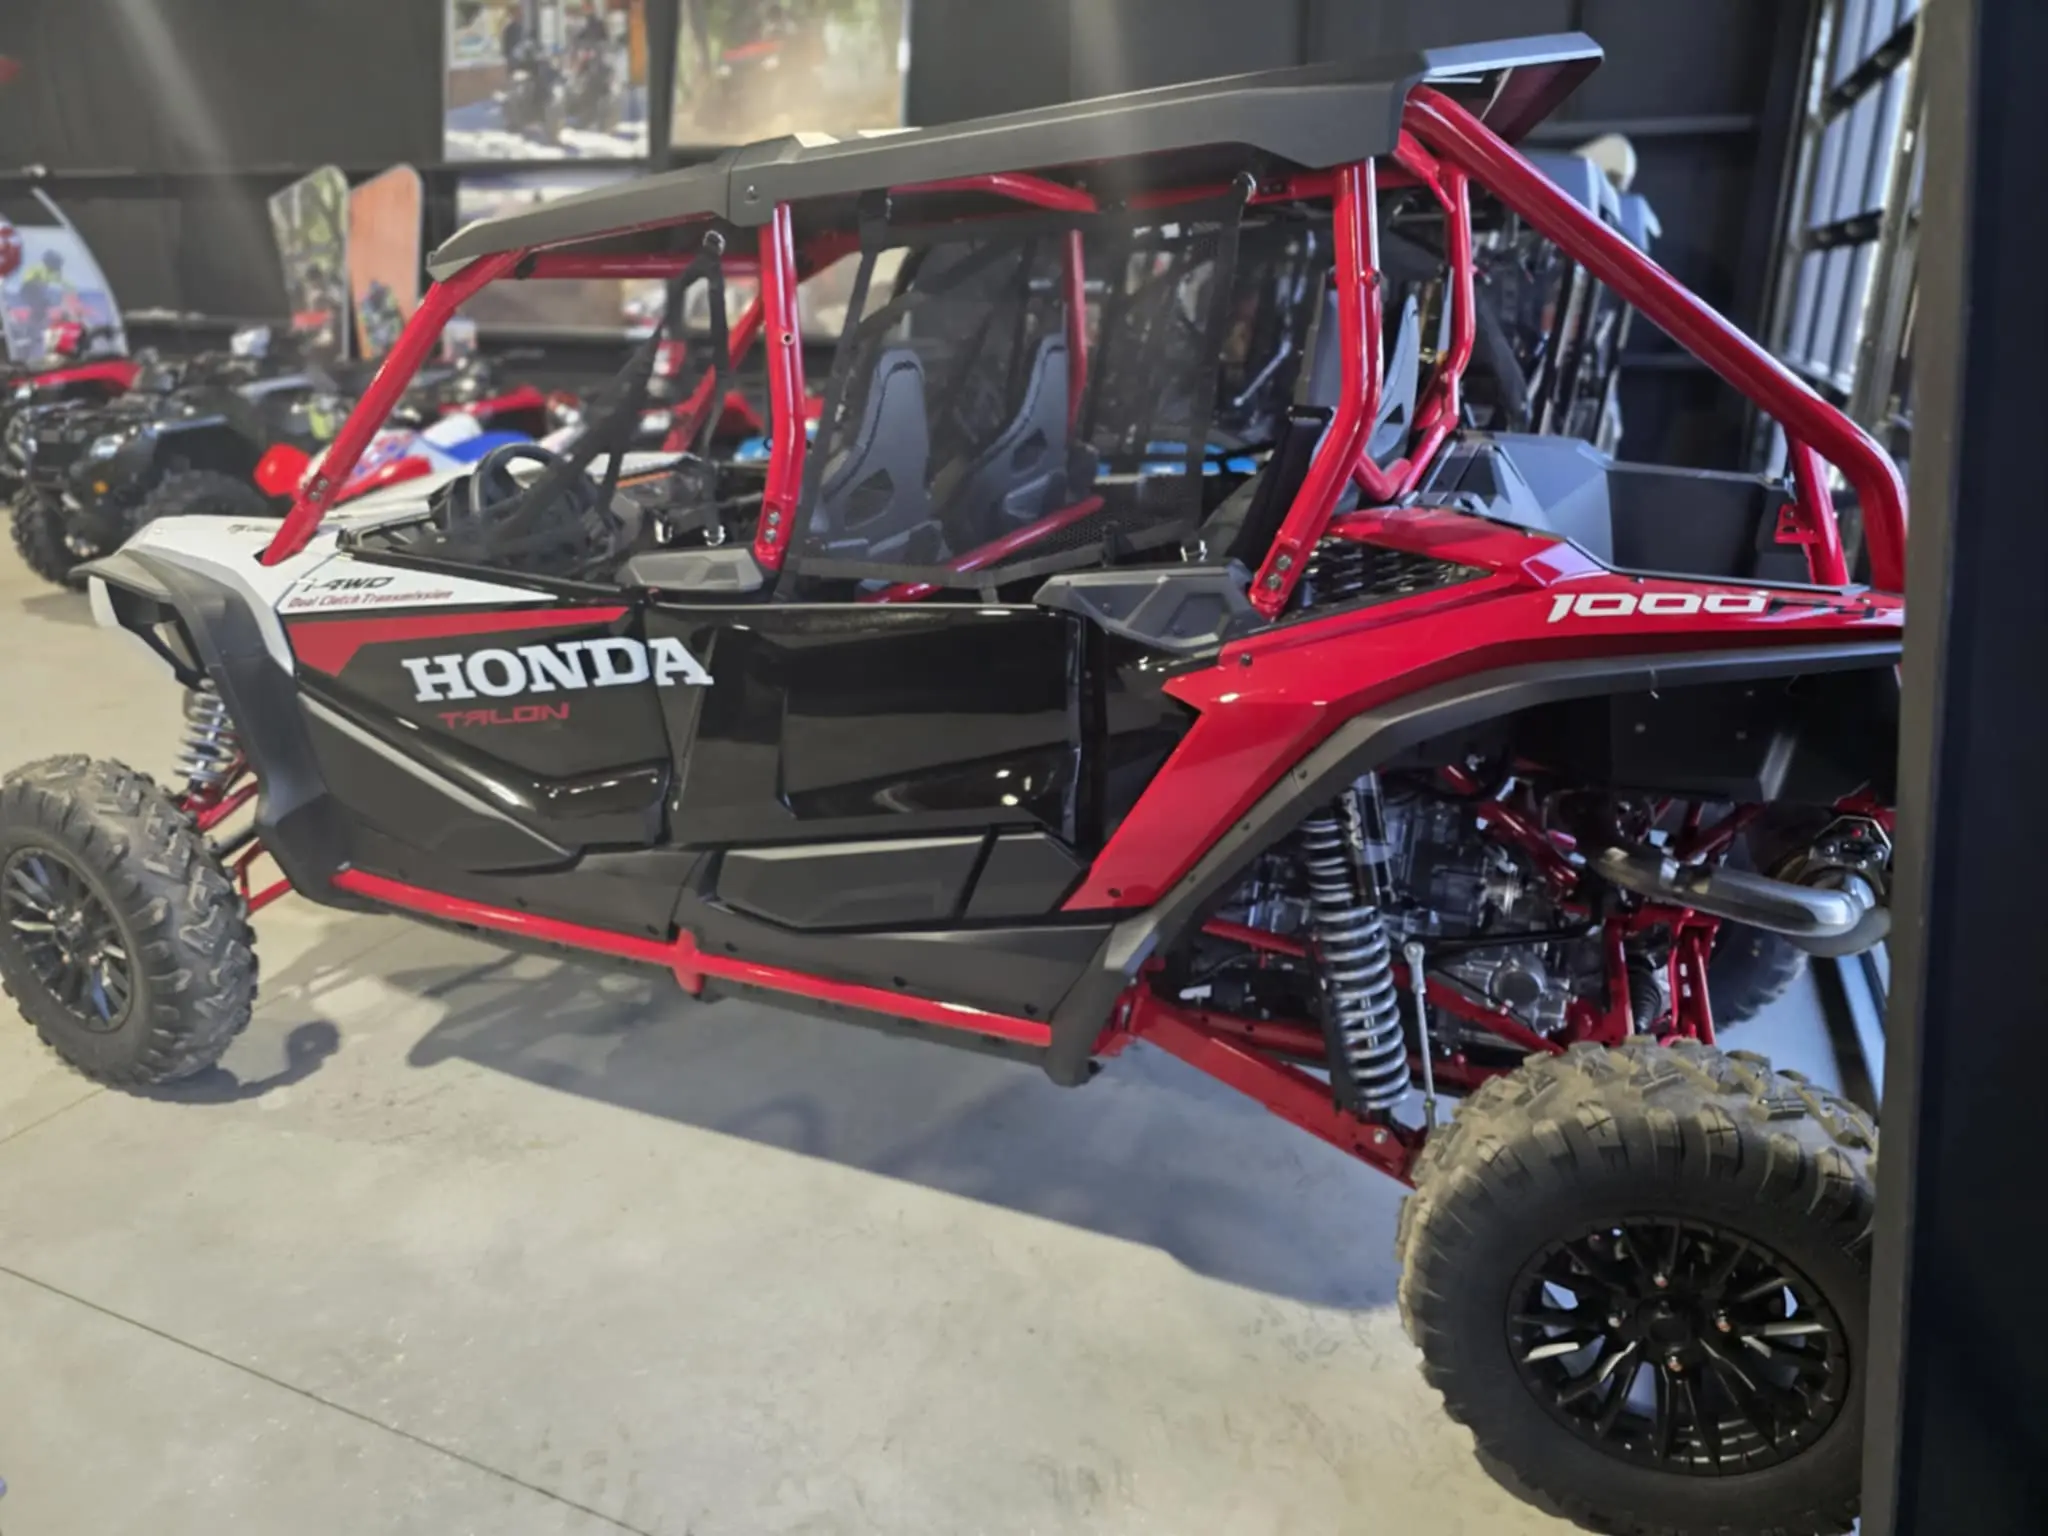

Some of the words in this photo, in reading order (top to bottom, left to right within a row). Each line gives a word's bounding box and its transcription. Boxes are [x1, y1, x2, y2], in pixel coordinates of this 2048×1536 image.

[361, 590, 454, 604] Transmission
[1547, 593, 1769, 623] 1000
[401, 637, 714, 702] HONDA
[438, 702, 571, 730] TALON
